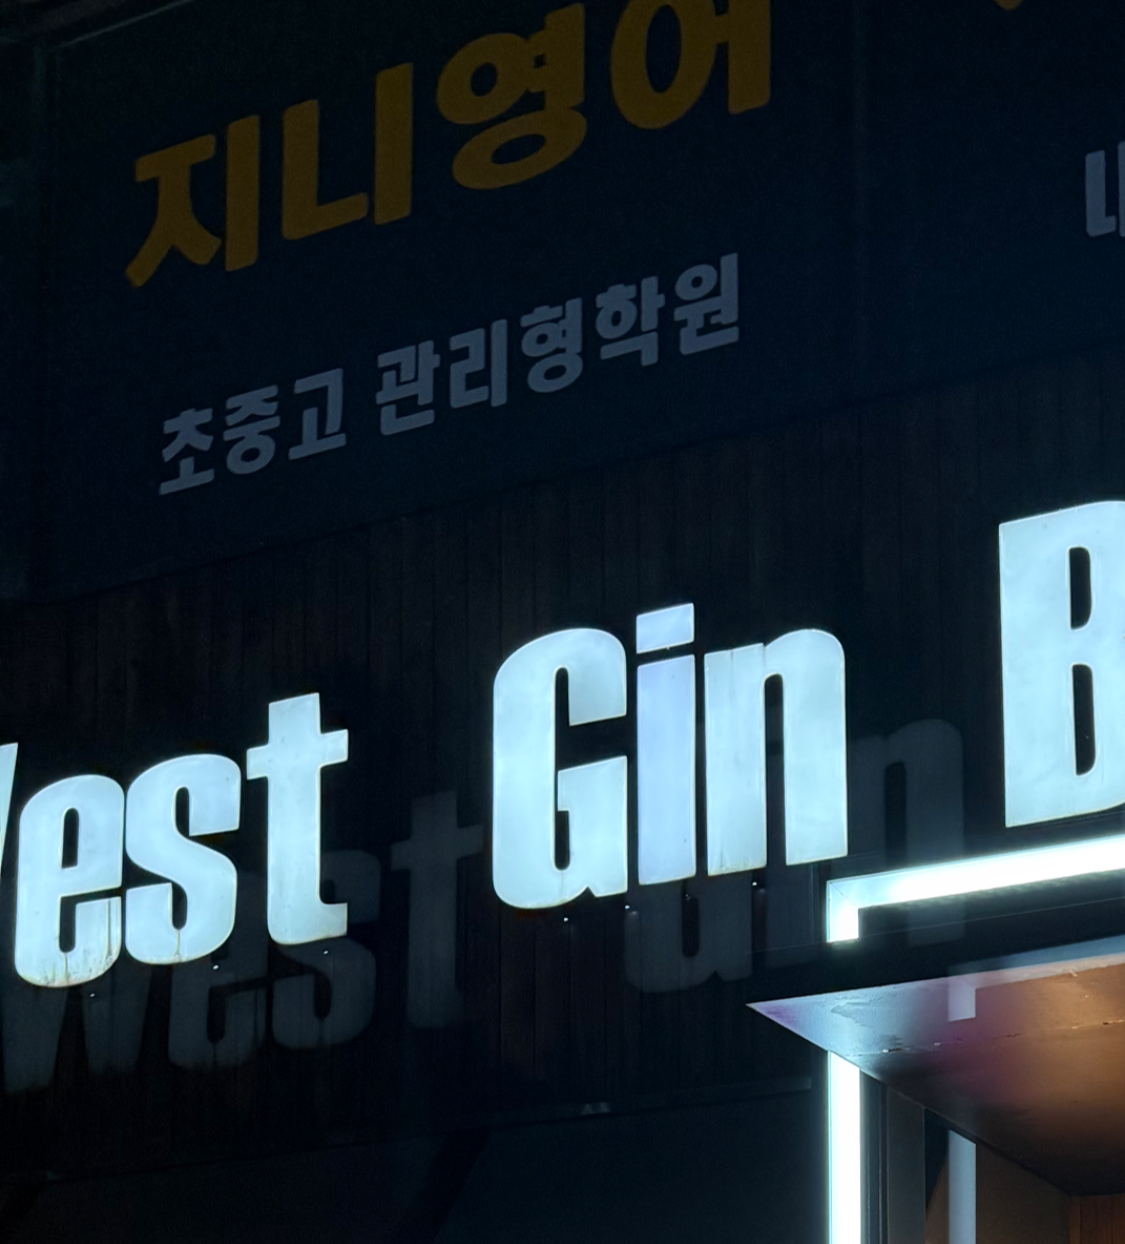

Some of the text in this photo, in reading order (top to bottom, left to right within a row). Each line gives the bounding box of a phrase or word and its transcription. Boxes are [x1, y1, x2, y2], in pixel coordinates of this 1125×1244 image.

[125, 0, 772, 288] 지니영어
[158, 252, 740, 496] 초중고 관리형학원
[0, 692, 349, 988] est
[491, 603, 848, 910] Gin
